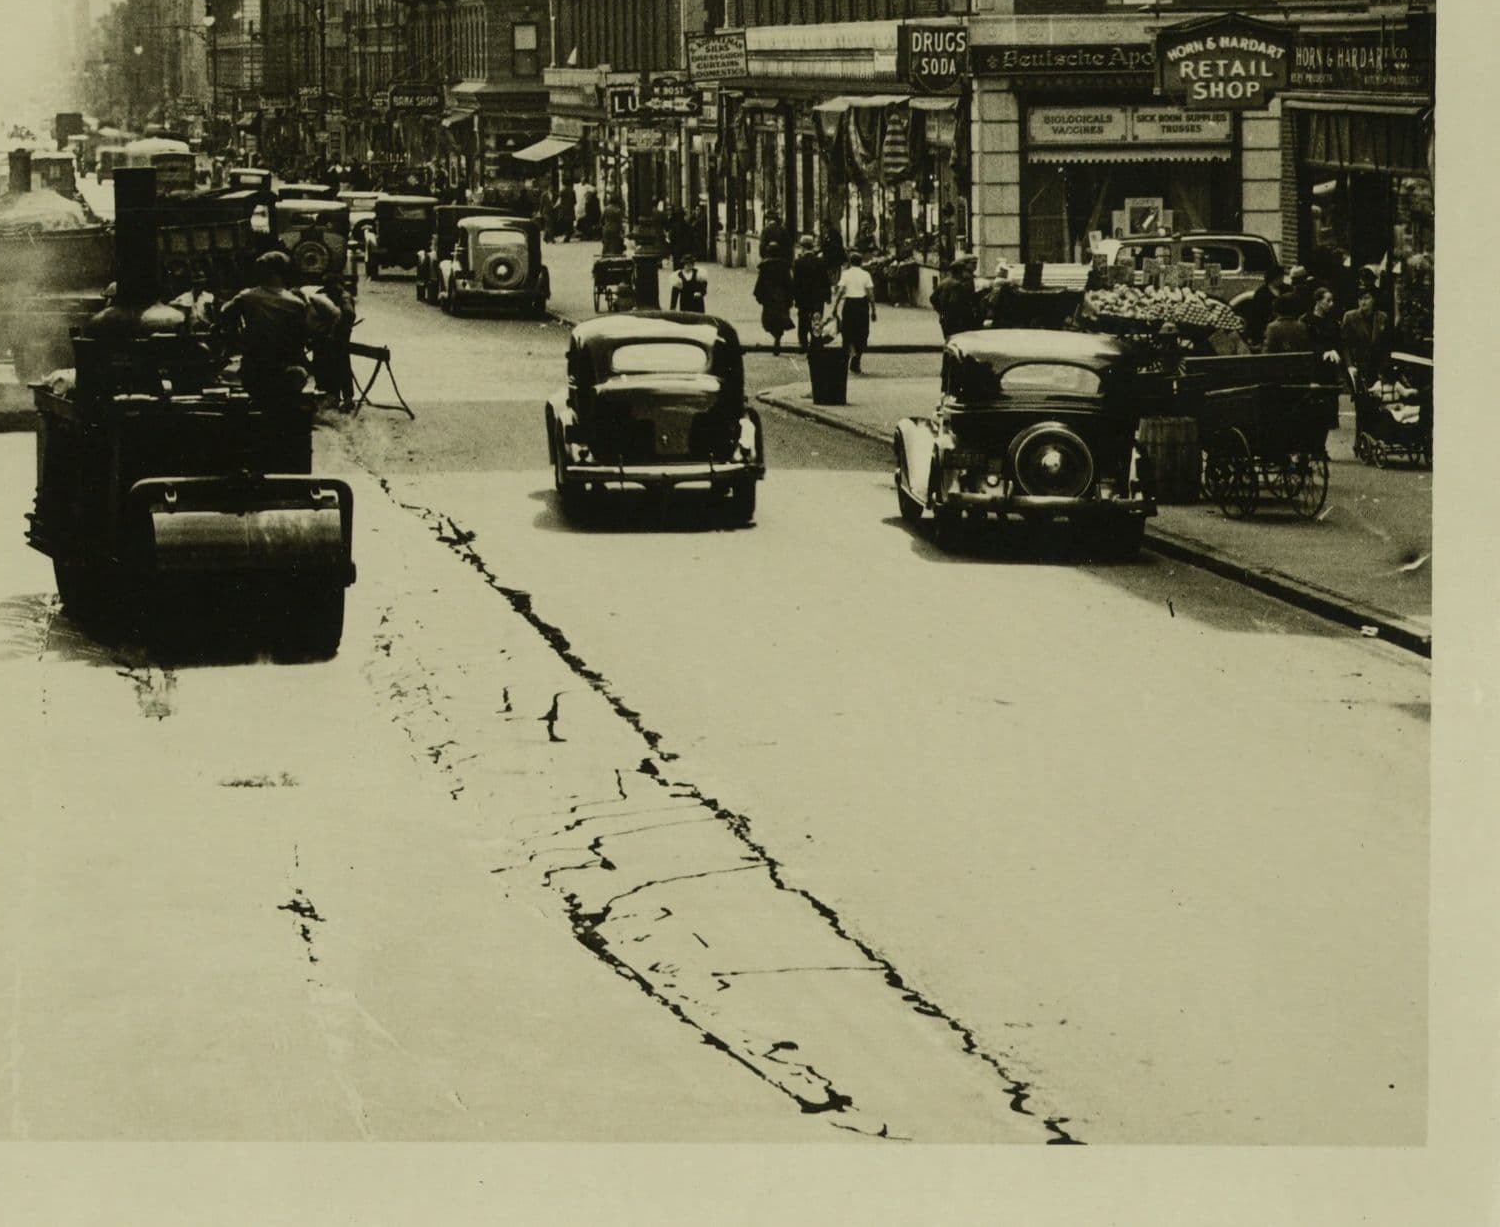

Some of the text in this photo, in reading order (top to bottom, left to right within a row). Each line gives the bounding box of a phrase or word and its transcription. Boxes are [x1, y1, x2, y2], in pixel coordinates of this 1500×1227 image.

[912, 32, 966, 52] DRUGS
[1167, 36, 1286, 61] HORN & HARDART
[921, 58, 956, 75] SODA
[1295, 47, 1322, 69] HORN
[1326, 47, 1333, 67] &
[1180, 60, 1274, 80] RETAIL
[1193, 81, 1260, 100] SHOP
[1043, 114, 1113, 124] BIOLOGICALS
[1136, 113, 1227, 123] SICK ROOM SUPPLIES
[1052, 125, 1104, 135] VACCINES
[1160, 124, 1203, 134] TRUSSES
